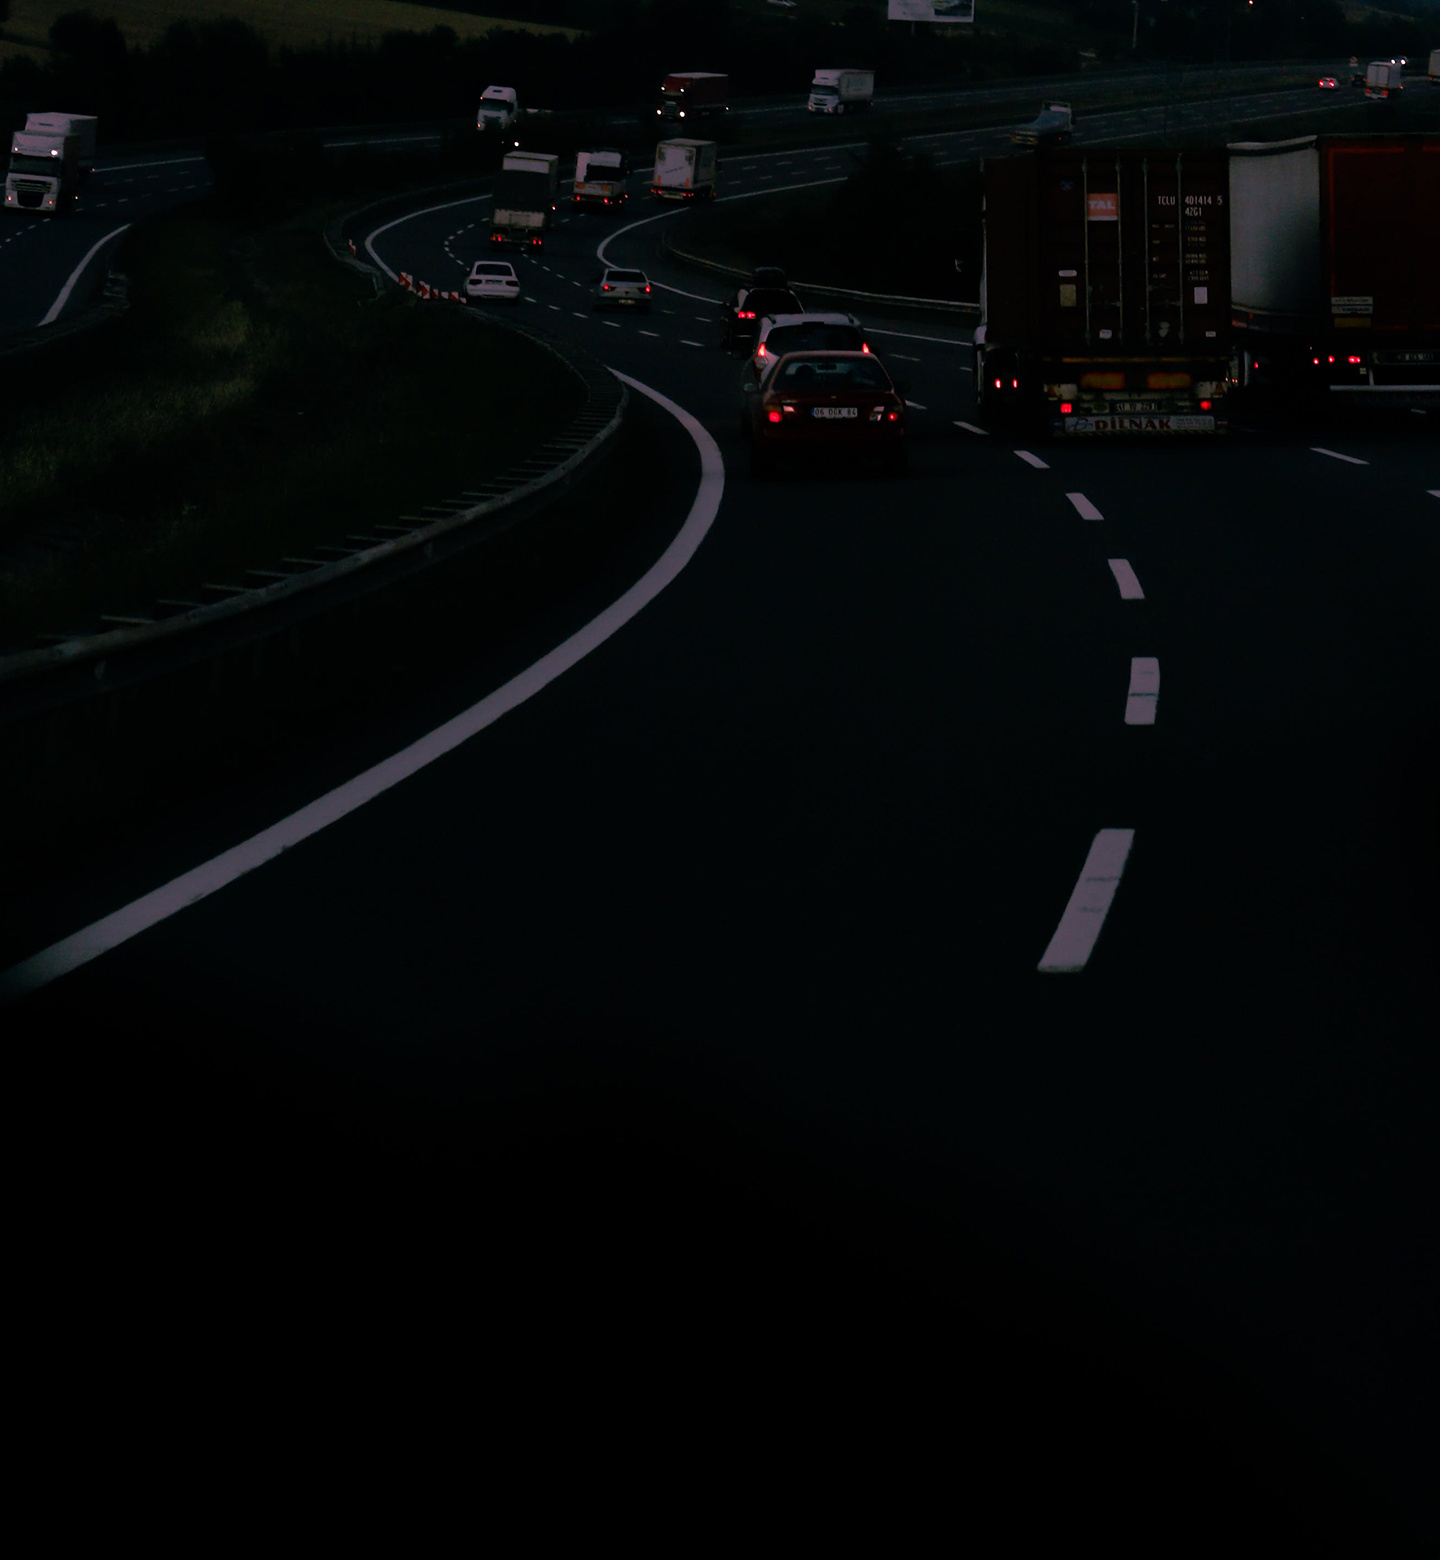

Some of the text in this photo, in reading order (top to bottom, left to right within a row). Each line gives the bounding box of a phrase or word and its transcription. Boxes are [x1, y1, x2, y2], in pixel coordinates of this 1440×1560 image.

[1088, 200, 1116, 210] TAL
[1158, 195, 1175, 205] TCLU
[1185, 195, 1212, 205] 401414
[815, 408, 824, 416] 06
